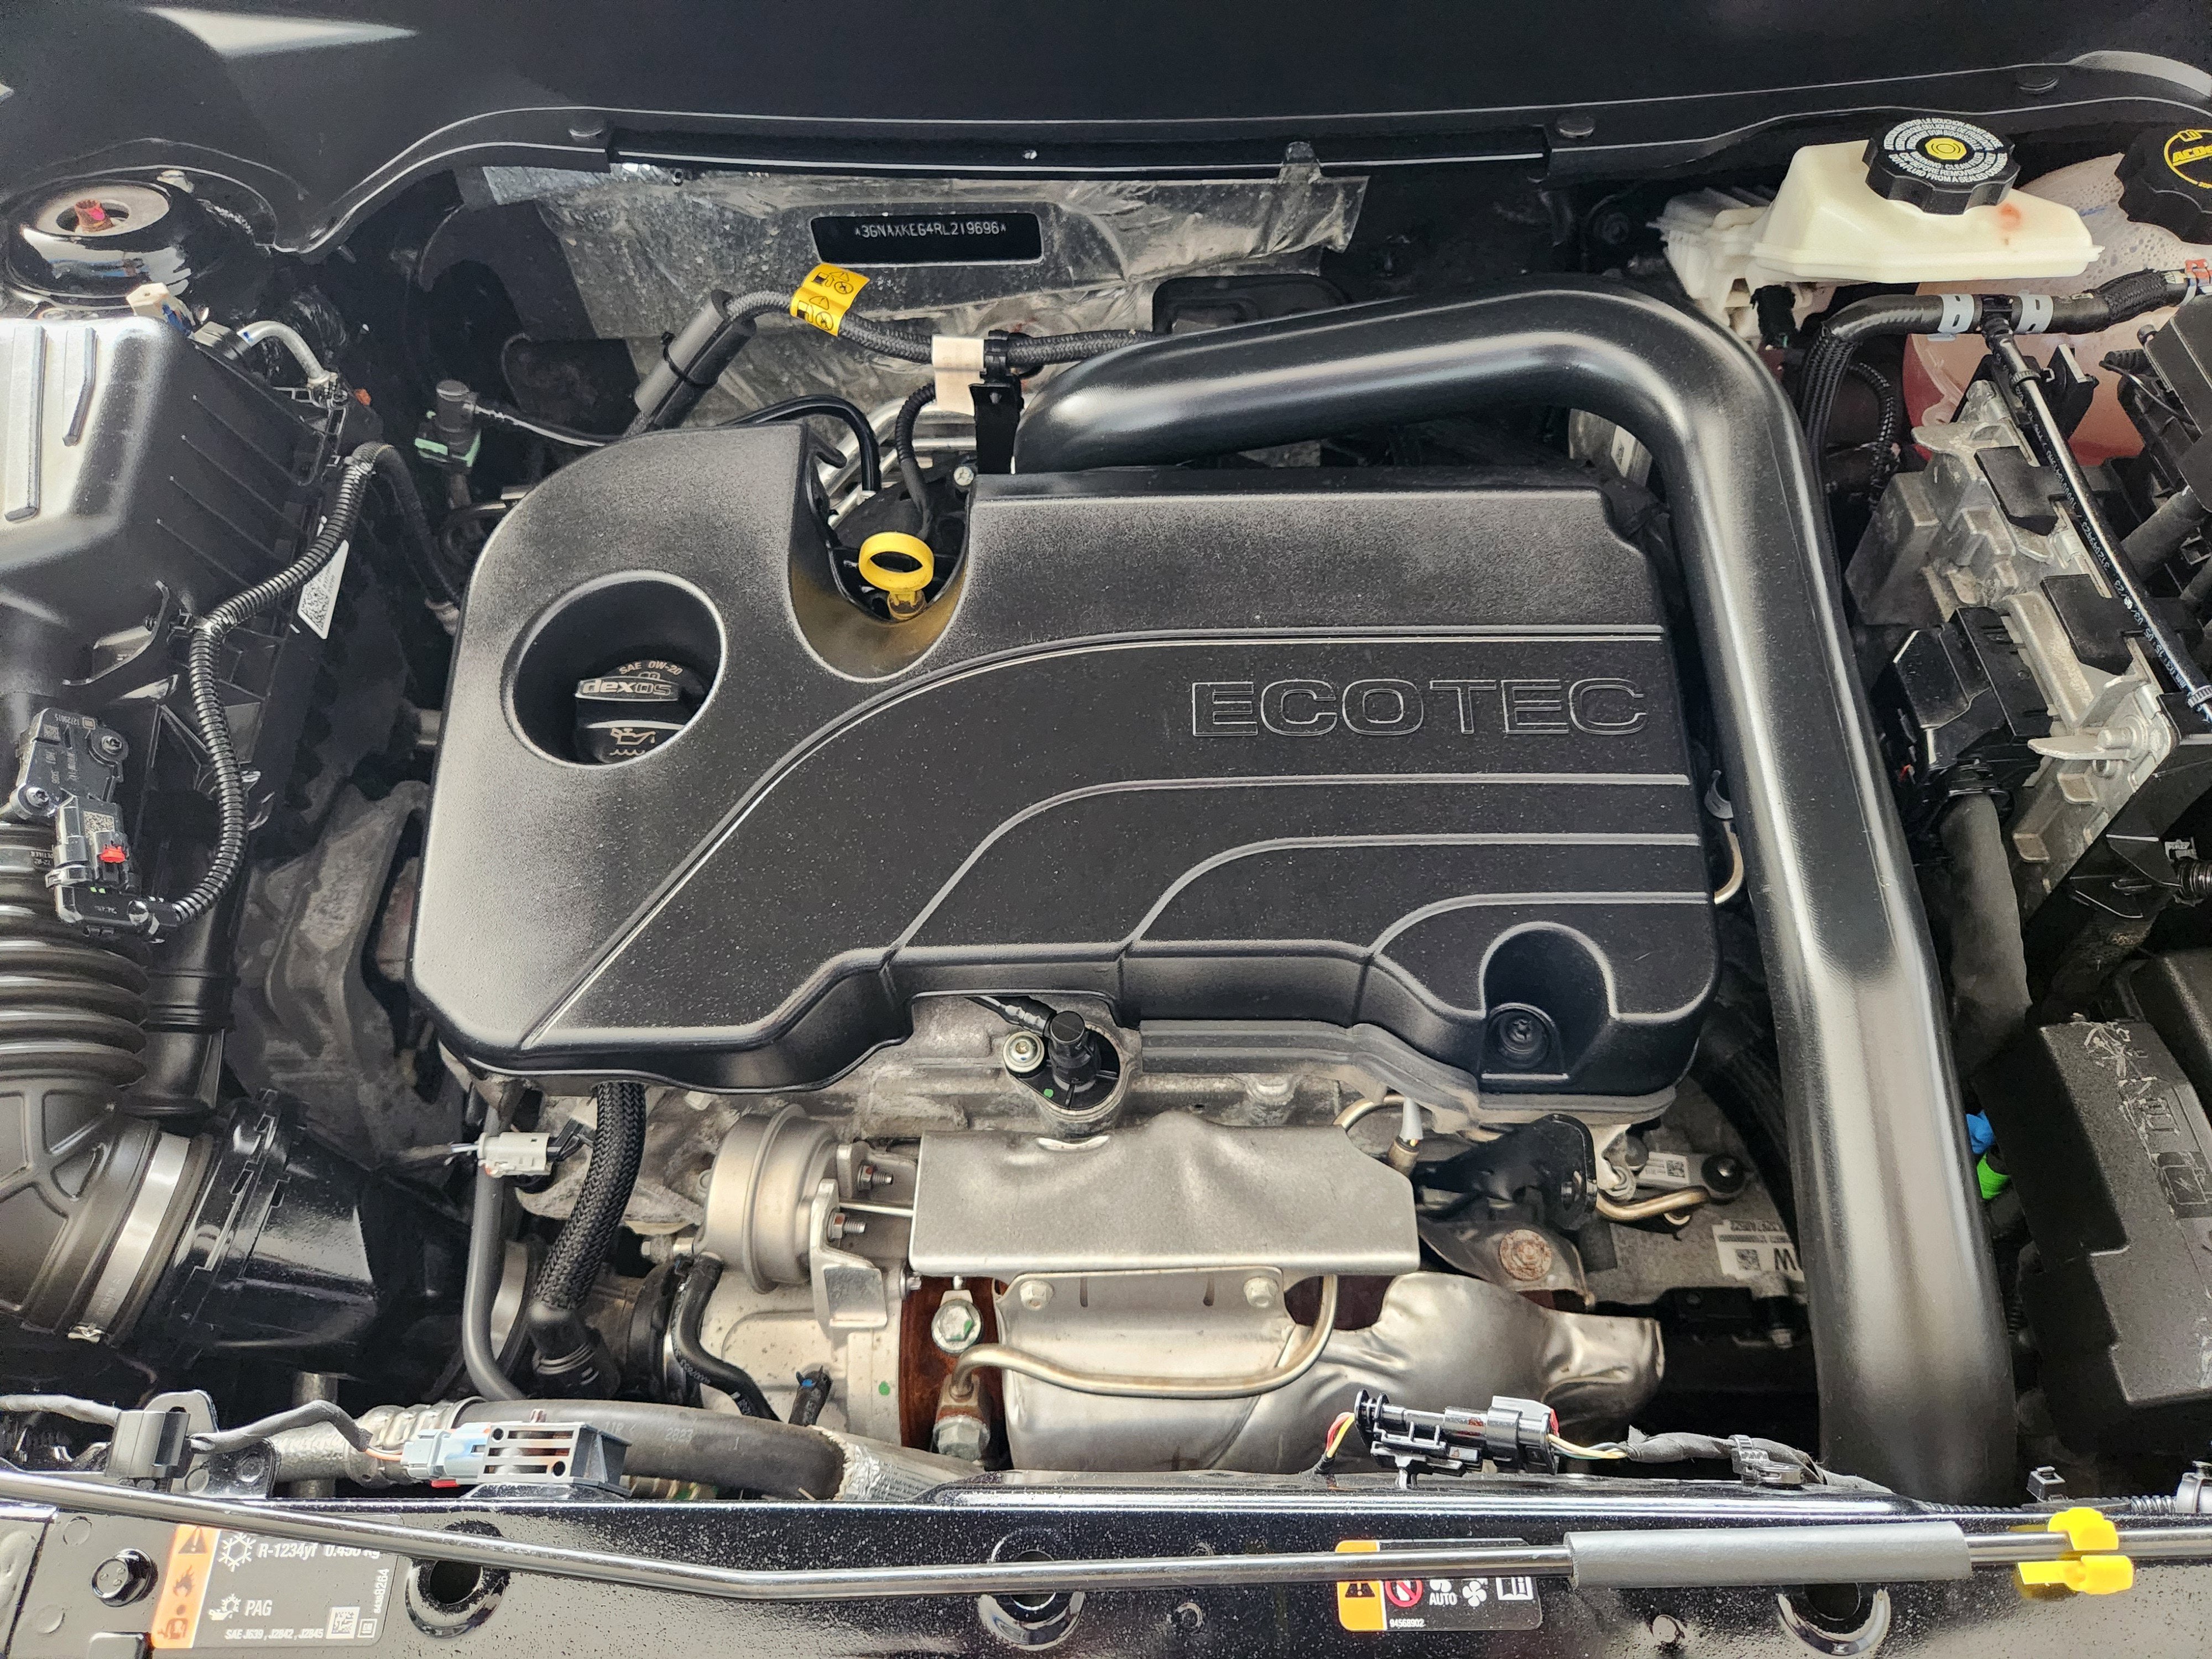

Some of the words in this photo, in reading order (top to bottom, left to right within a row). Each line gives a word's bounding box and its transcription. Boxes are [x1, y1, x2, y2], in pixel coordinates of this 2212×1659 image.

[1932, 118, 1965, 128] BOUCHON
[1910, 160, 1940, 174] BEFORE
[1926, 173, 1951, 182] FROM
[1958, 173, 1989, 184] SEALED
[619, 662, 643, 675] SAE
[648, 660, 684, 676] 0W-20
[582, 679, 672, 697] dexos
[1191, 677, 1648, 737] ECOTEC
[1428, 1592, 1458, 1606] AUTO
[244, 1599, 273, 1617] PAG
[225, 1629, 243, 1640] SAE
